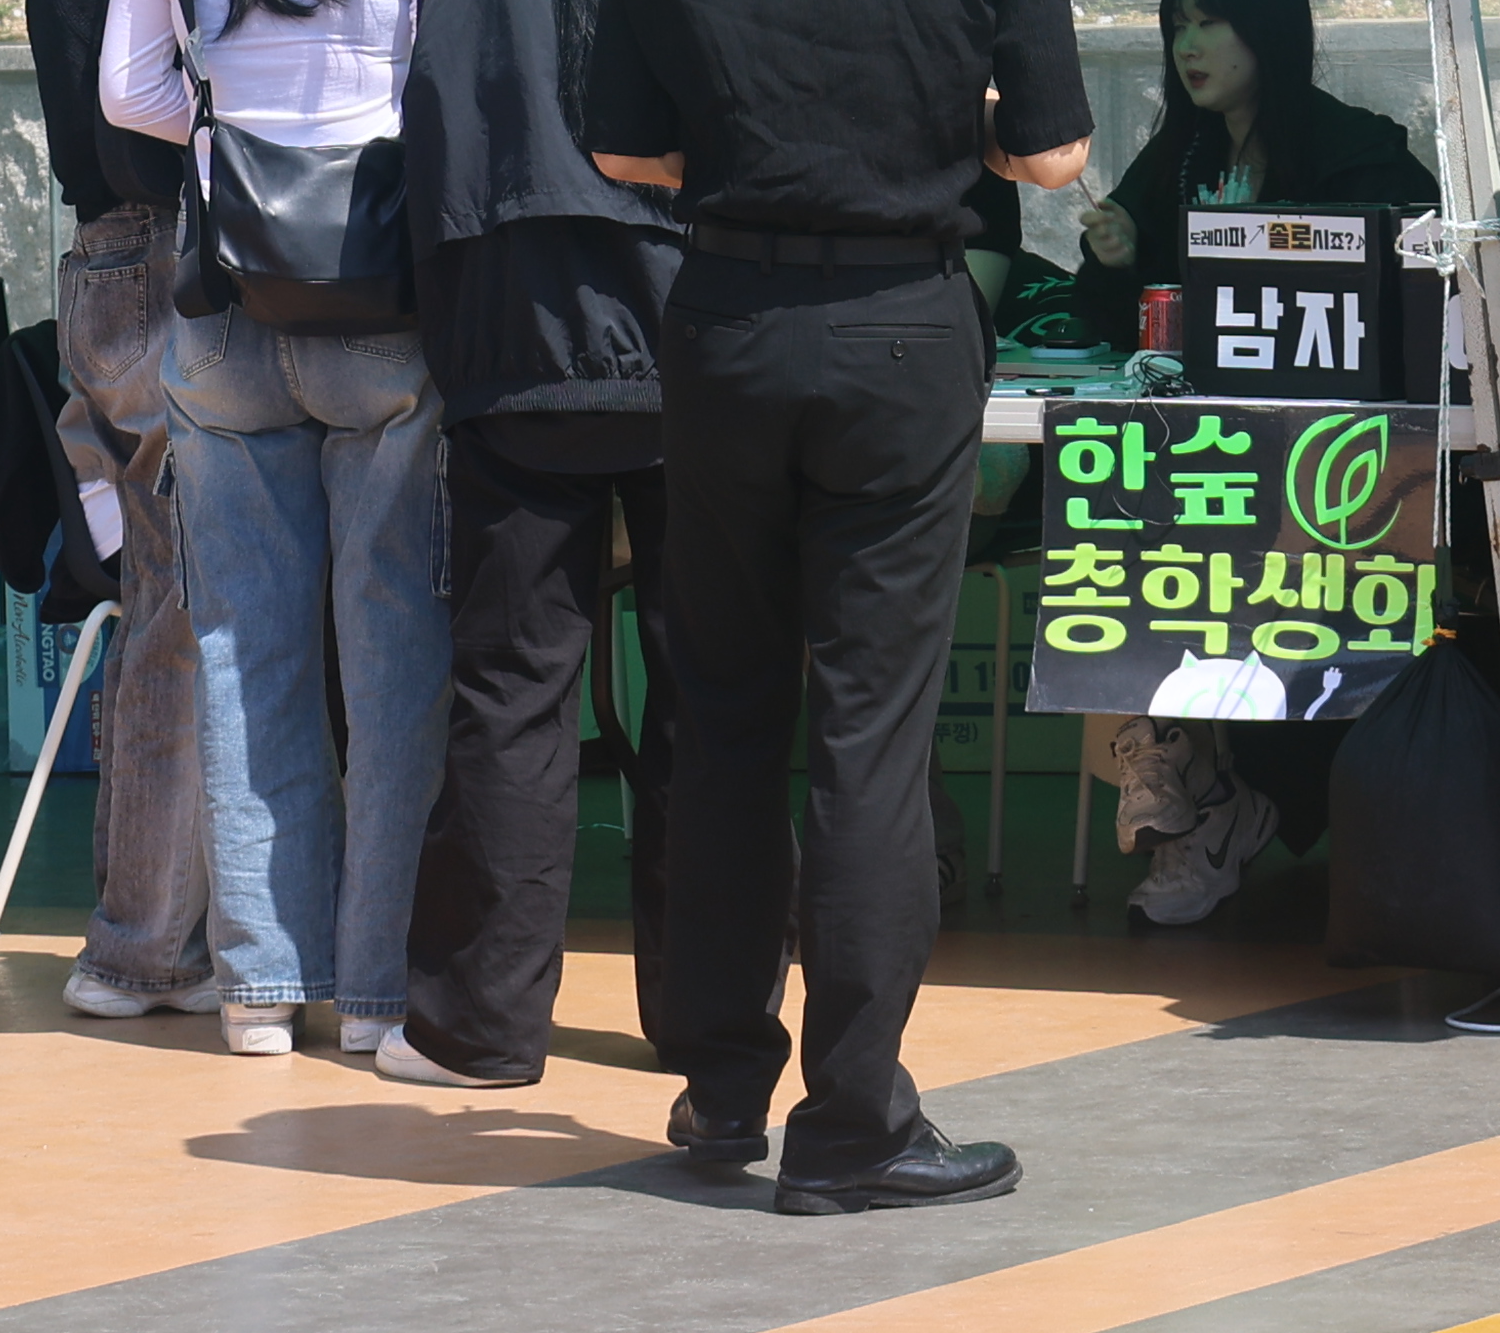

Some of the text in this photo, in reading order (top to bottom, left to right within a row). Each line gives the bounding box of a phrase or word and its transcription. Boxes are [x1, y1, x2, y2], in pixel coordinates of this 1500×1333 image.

[1190, 226, 1247, 248] 도레미파
[1216, 286, 1366, 371] 남자
[1055, 415, 1259, 530] 한숲
[1041, 542, 1437, 660] 총학생회
